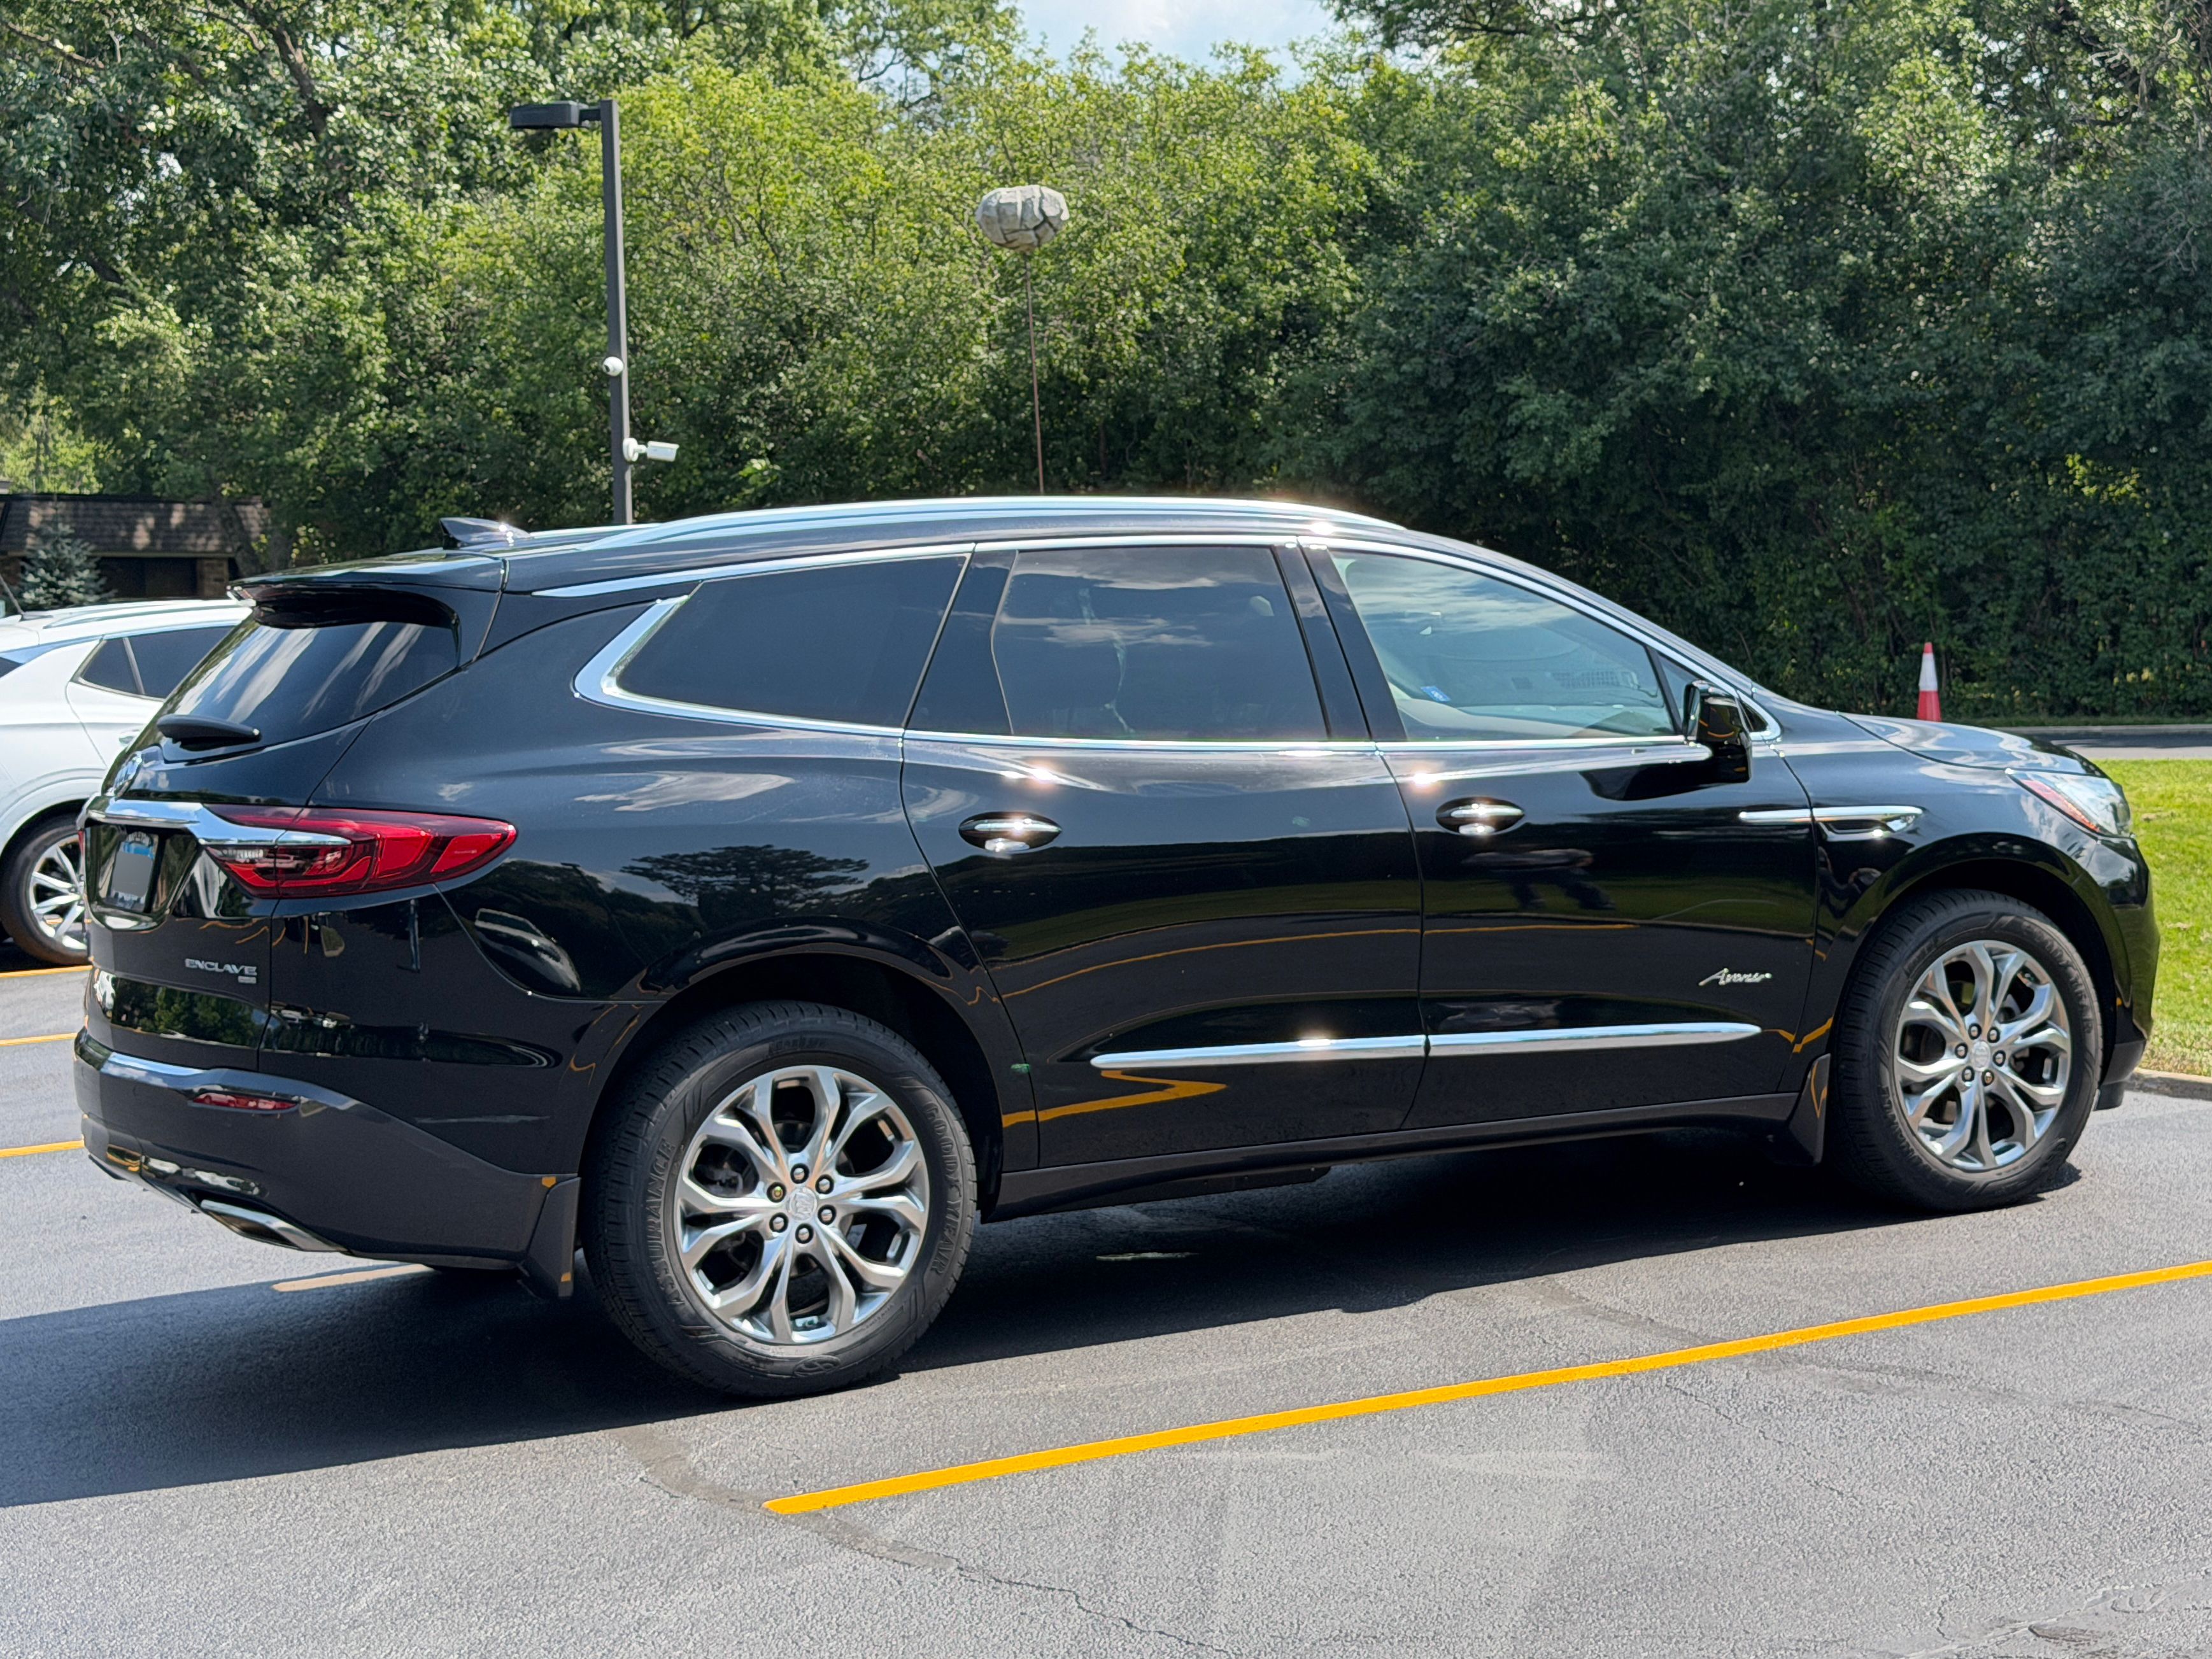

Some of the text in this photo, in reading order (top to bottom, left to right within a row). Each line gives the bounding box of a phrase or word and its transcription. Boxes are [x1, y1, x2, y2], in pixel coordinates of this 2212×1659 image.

[184, 958, 257, 976] ENCLAVE
[646, 1137, 686, 1305] ASSURANCE
[924, 1101, 962, 1274] GOODYEAR
